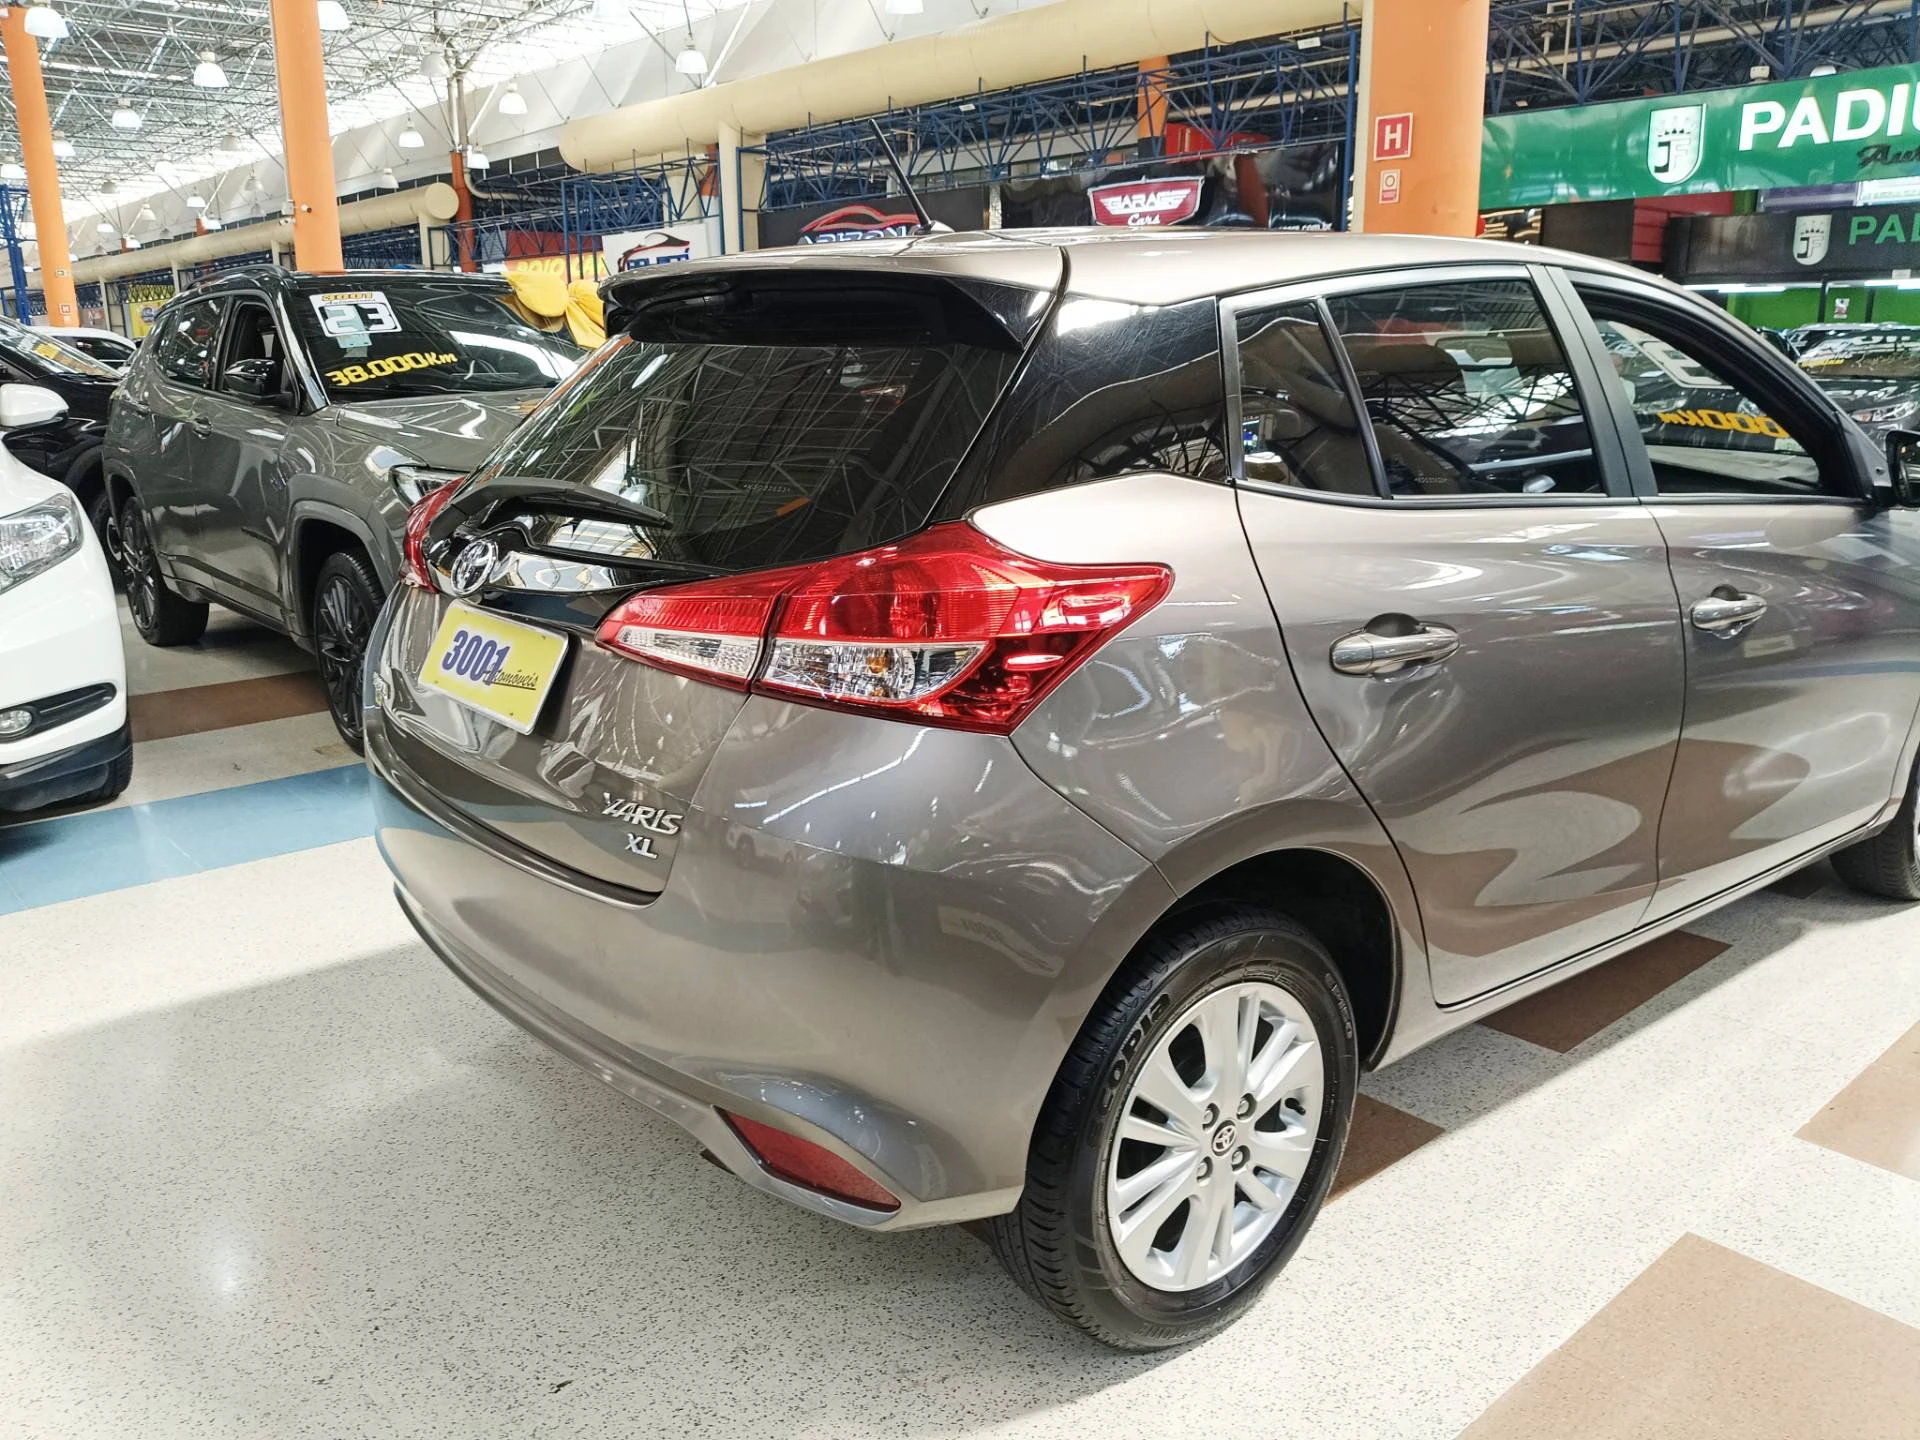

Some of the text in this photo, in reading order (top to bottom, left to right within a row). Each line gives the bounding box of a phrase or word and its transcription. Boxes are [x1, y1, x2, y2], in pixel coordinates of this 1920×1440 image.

[1739, 83, 1920, 151] PADI
[1384, 123, 1402, 151] H
[1849, 212, 1920, 246] PA
[323, 303, 396, 334] 23
[442, 630, 511, 686] 3001
[602, 792, 684, 835] YARIS
[624, 833, 658, 859] XL
